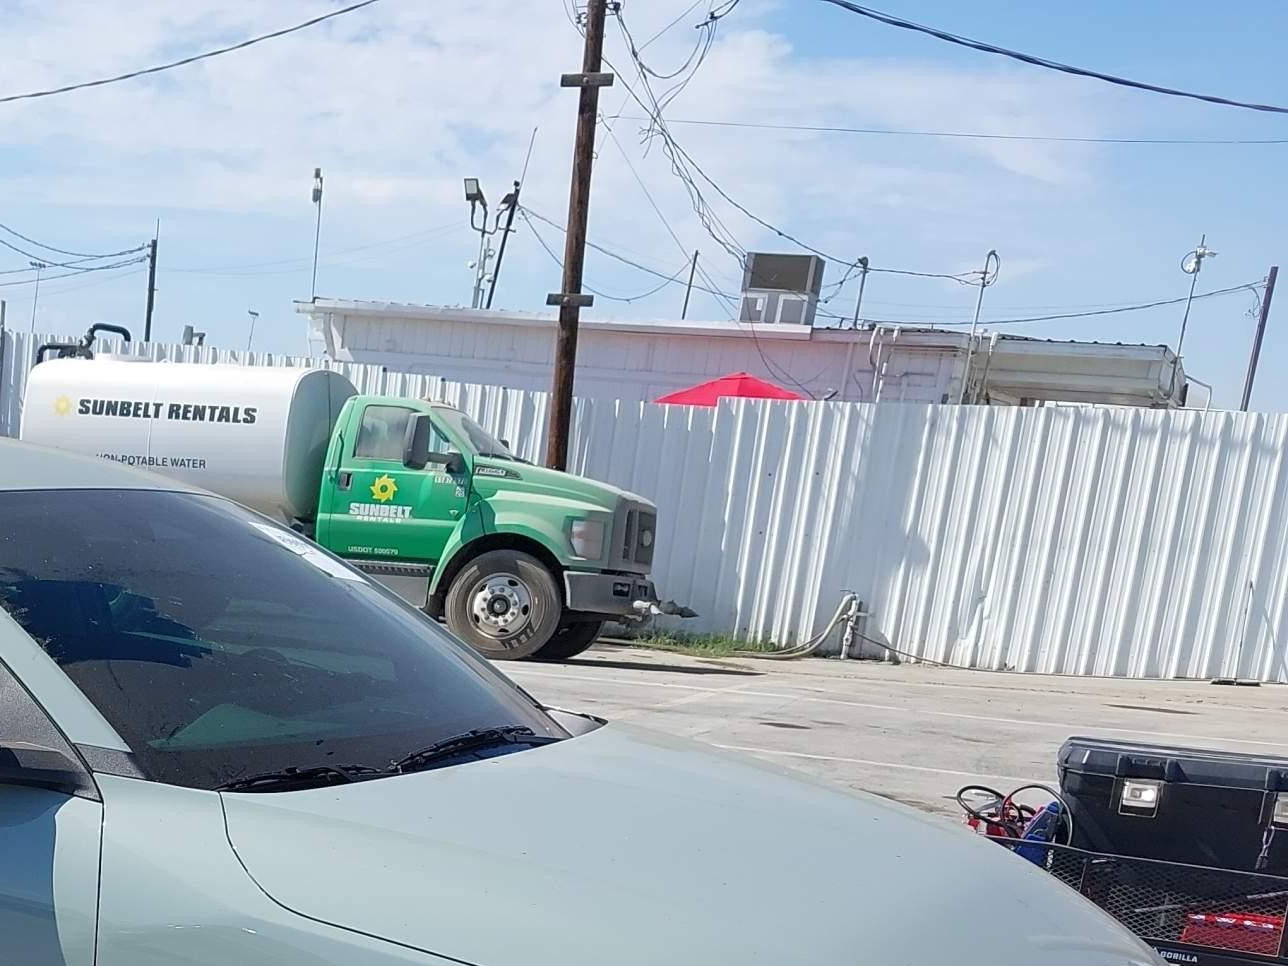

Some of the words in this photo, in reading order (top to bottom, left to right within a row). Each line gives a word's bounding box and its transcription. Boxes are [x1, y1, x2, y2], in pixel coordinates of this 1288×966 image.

[78, 398, 163, 419] SUNBELT
[167, 403, 257, 425] RENTALS
[170, 458, 206, 469] WATER
[349, 502, 413, 518] SUNBELT
[1160, 950, 1198, 963] GORILLA
